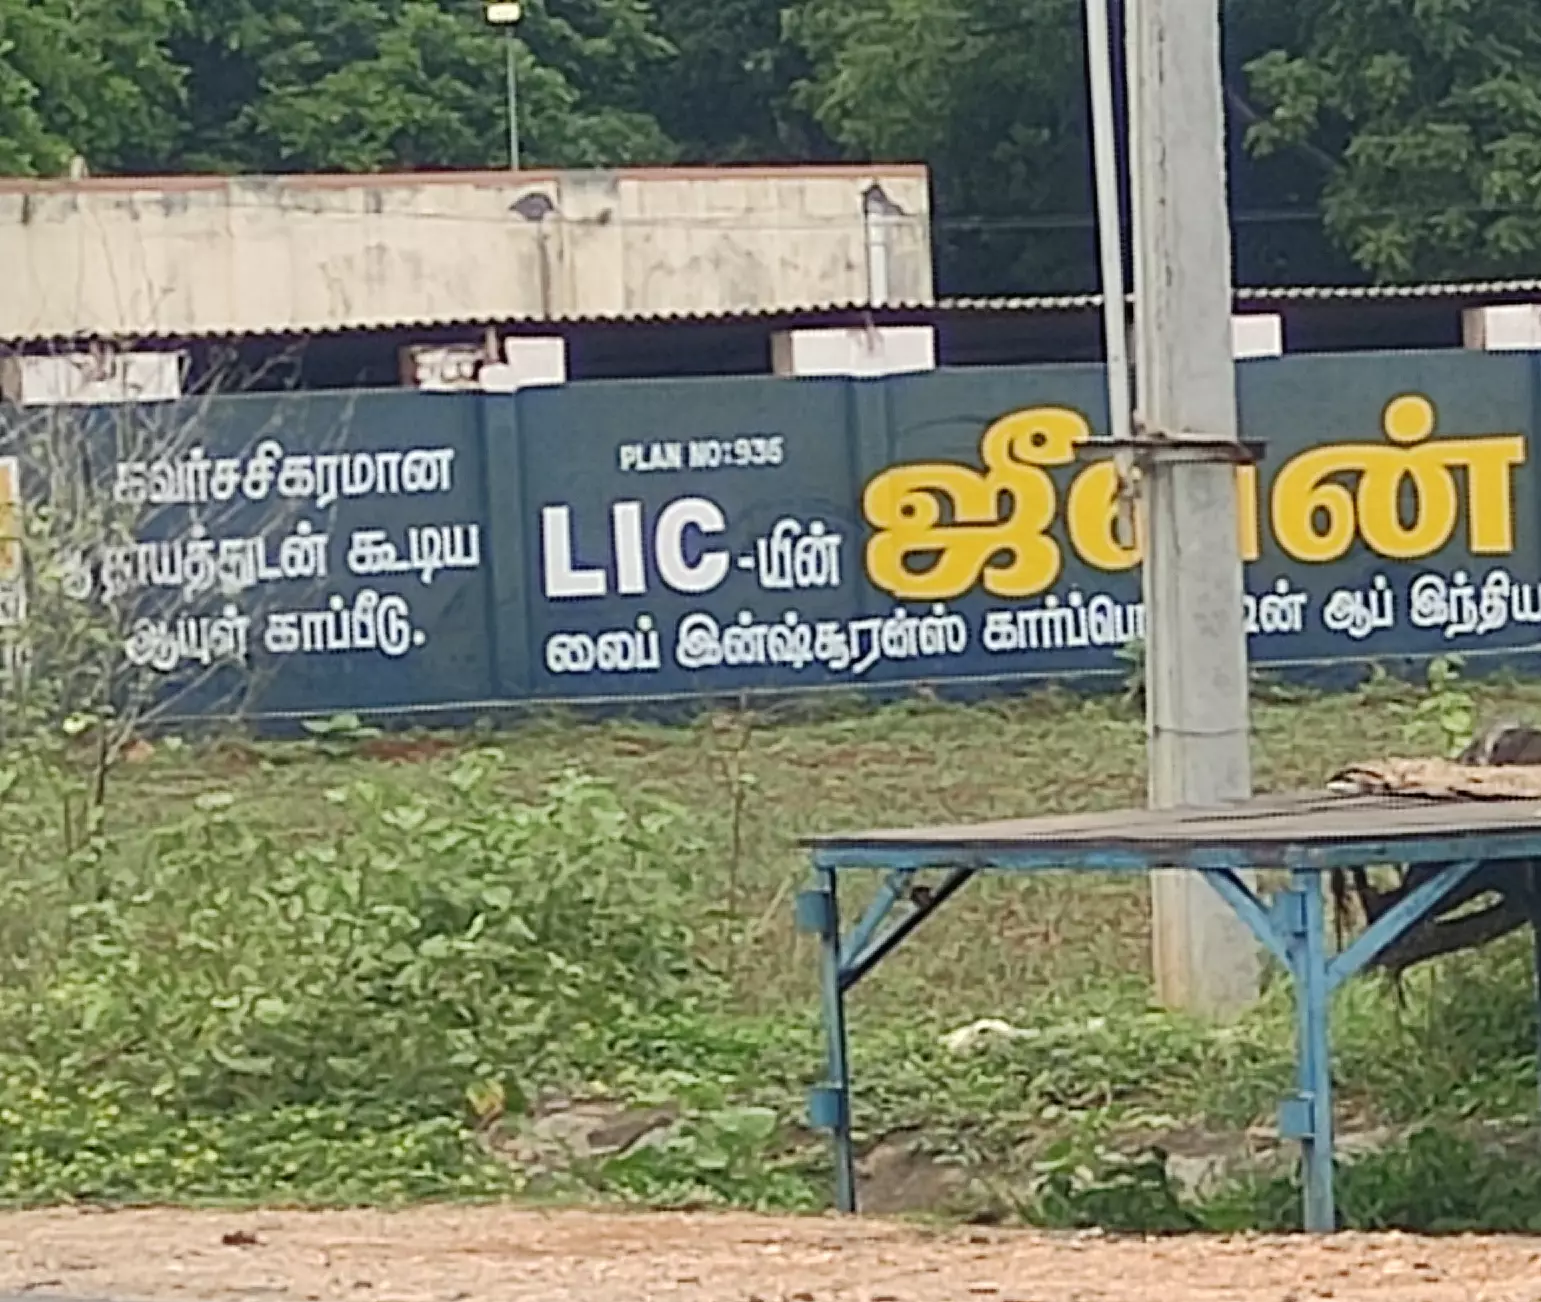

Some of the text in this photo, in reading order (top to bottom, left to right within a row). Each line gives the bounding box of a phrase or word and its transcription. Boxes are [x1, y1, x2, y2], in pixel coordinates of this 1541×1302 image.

[620, 442, 682, 472] PLAN
[347, 521, 481, 585] கூடிய
[545, 614, 661, 674] லைப்
[1323, 574, 1395, 639] ஆப்
